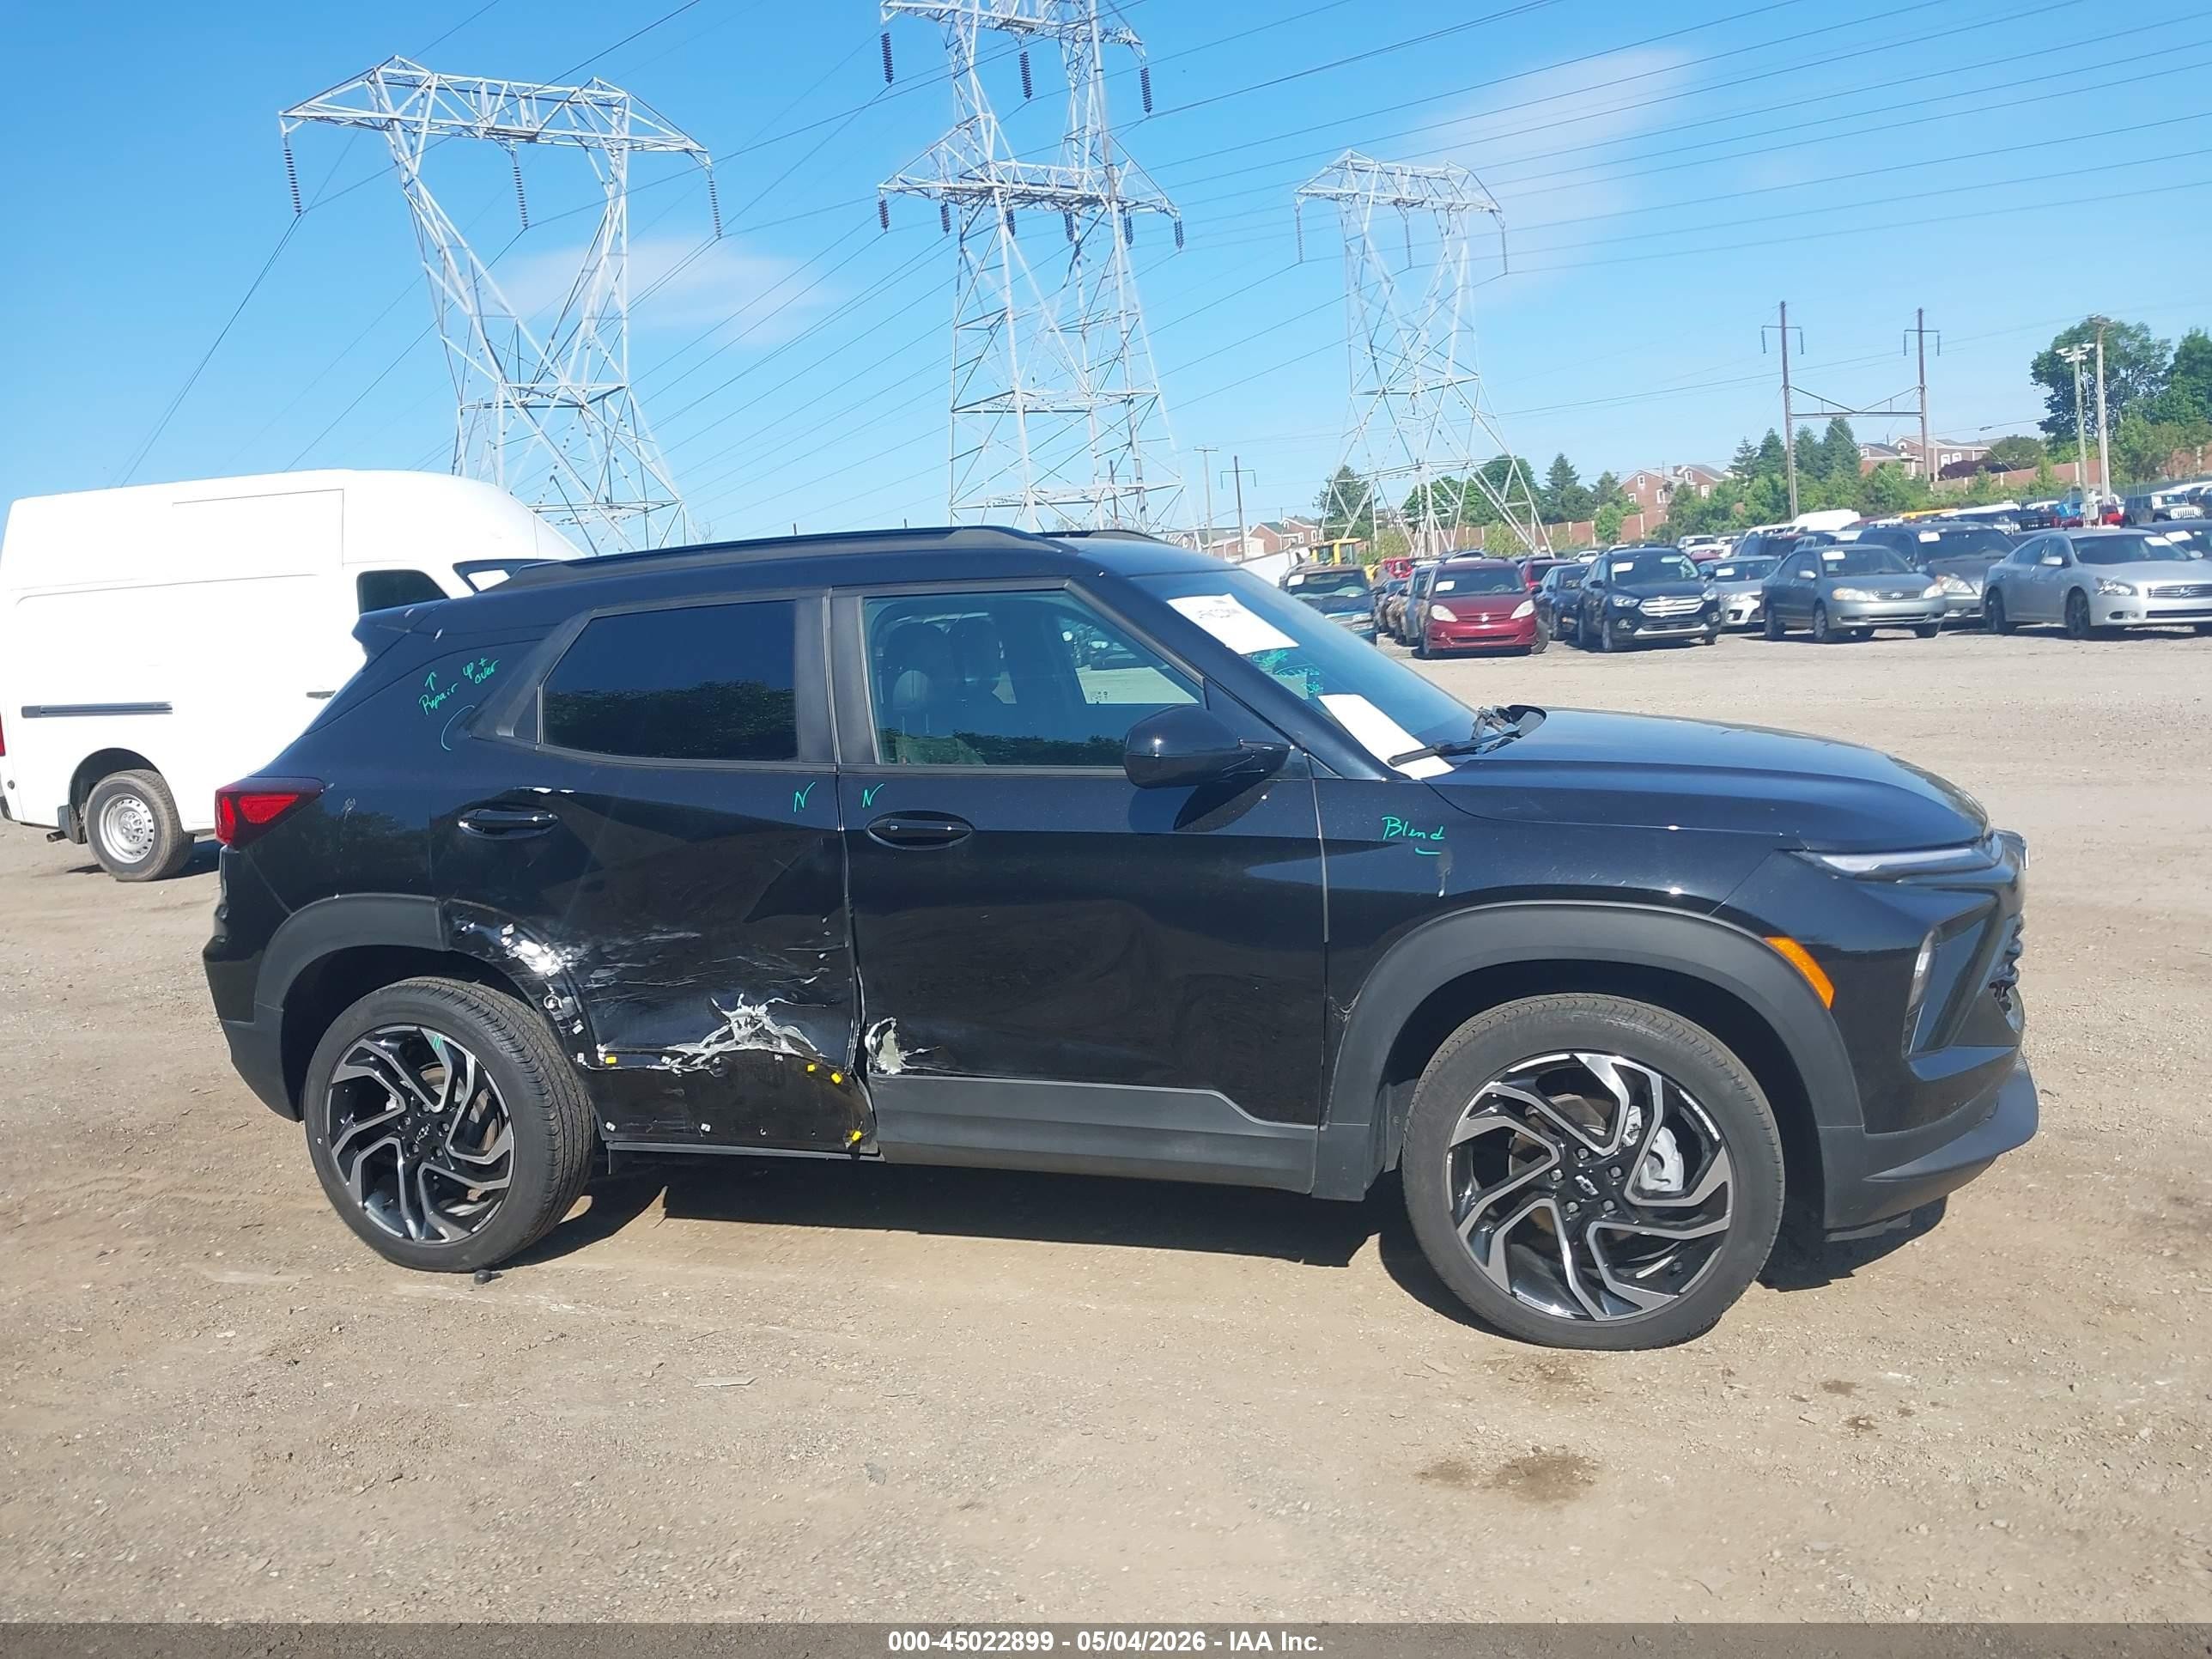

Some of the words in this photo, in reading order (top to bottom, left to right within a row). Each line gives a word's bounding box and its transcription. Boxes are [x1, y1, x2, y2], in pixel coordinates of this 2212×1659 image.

[474, 659, 500, 684] over
[418, 682, 459, 715] Repair
[1381, 816, 1445, 841] Blend
